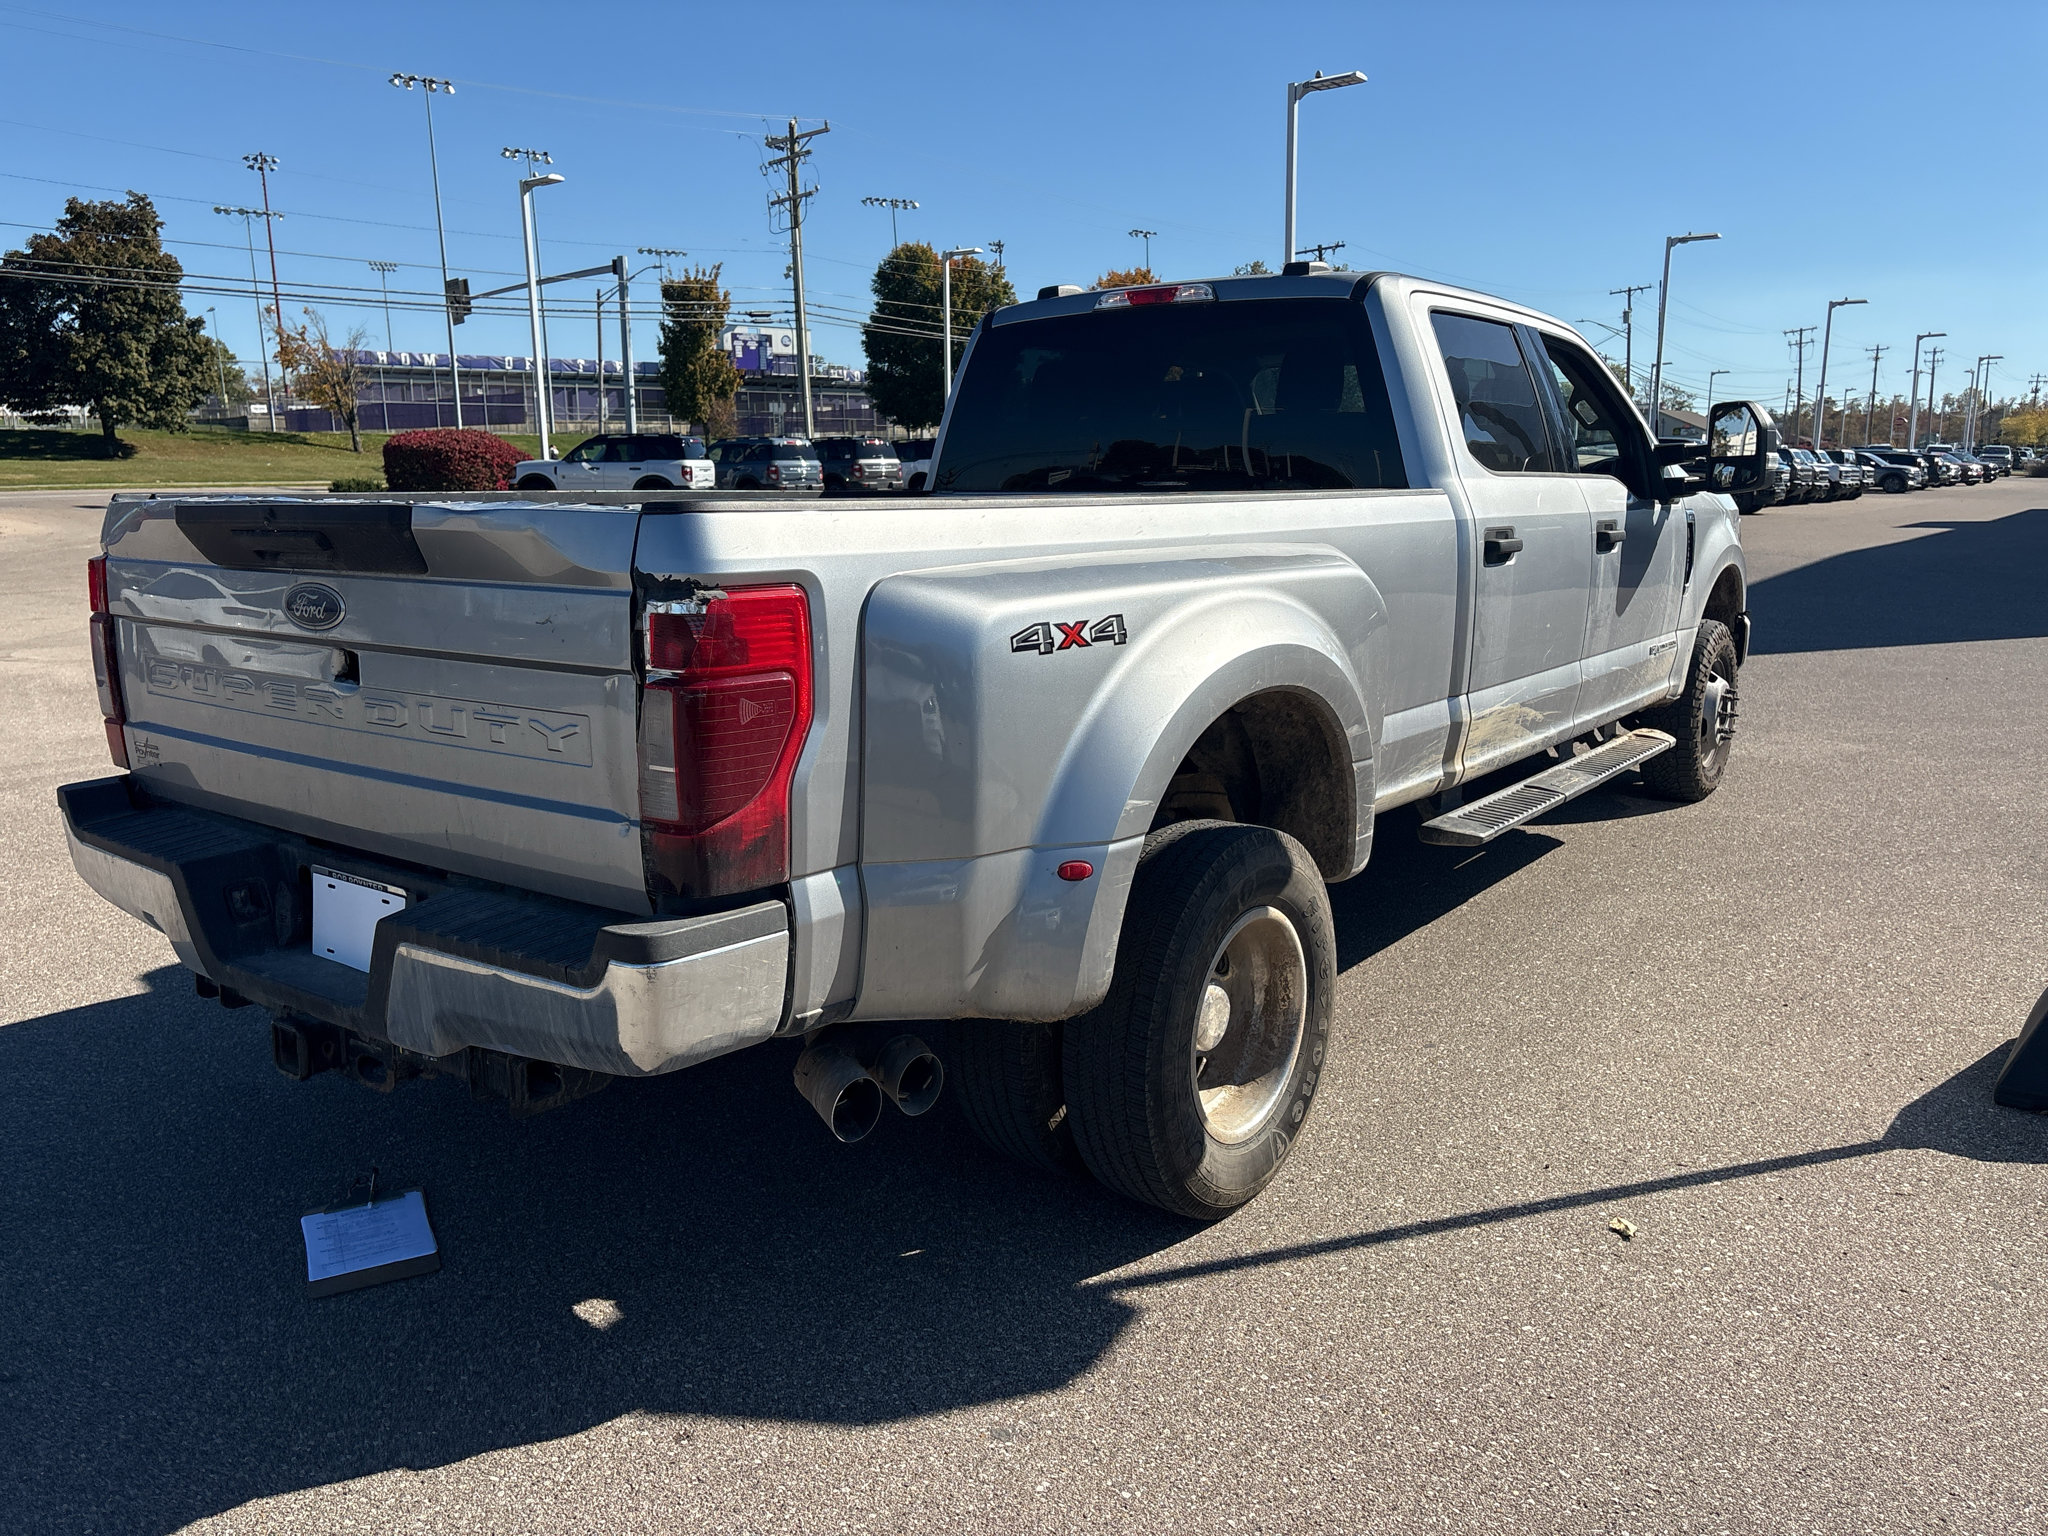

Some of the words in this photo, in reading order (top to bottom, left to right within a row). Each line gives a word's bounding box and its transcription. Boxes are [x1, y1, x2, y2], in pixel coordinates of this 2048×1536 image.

[377, 351, 459, 368] HOM
[293, 592, 327, 620] Ford
[149, 661, 345, 720] SUPER
[364, 696, 580, 753] DUTY
